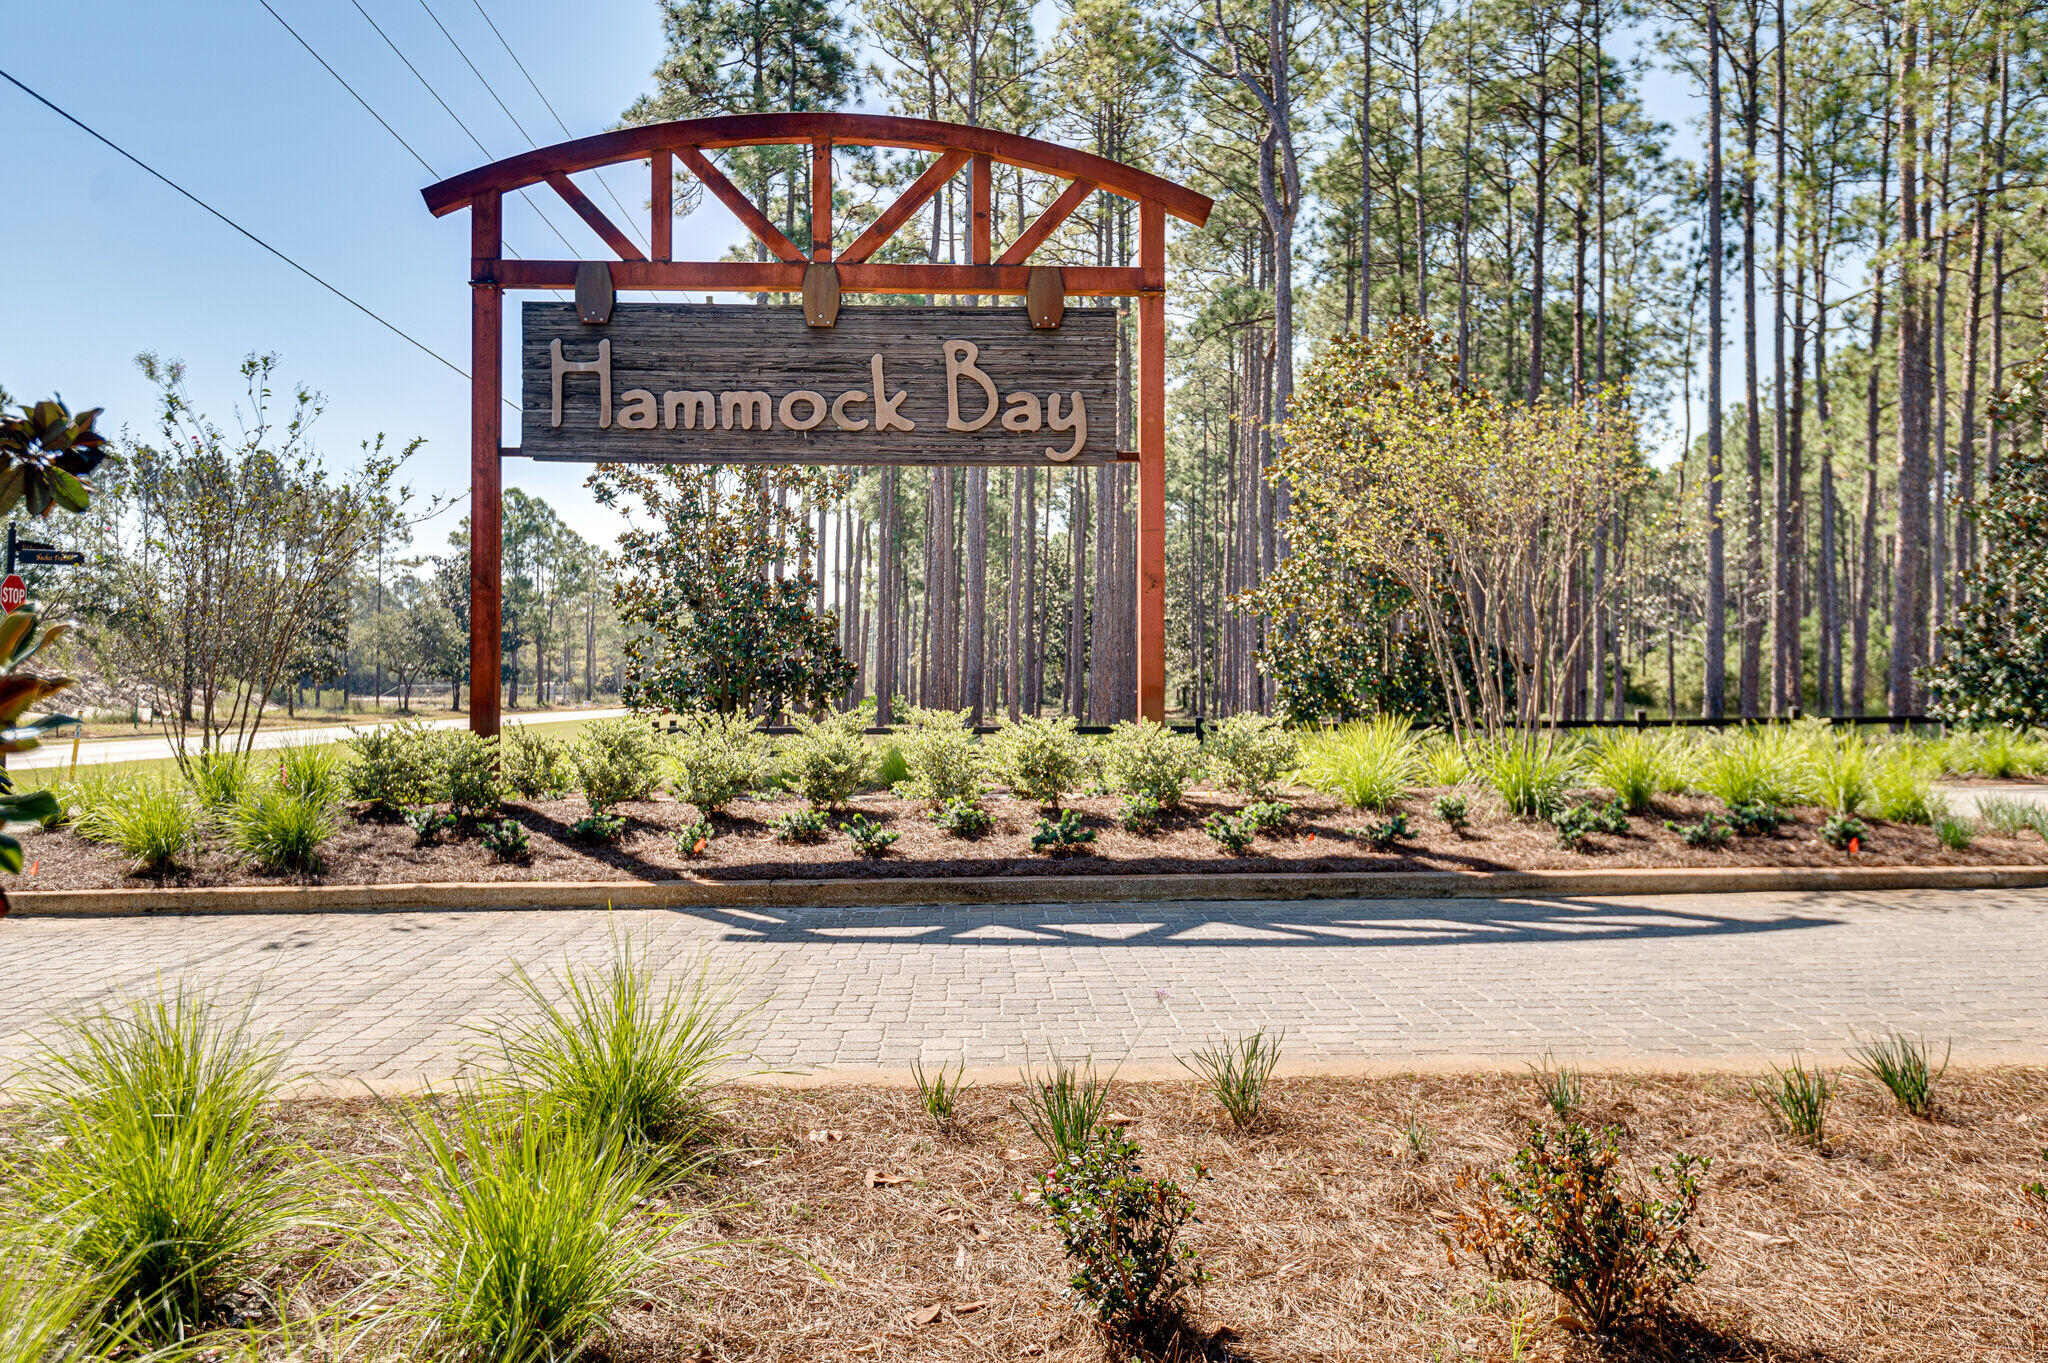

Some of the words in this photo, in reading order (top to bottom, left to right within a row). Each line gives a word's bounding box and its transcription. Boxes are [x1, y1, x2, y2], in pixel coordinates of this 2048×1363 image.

[550, 337, 916, 432] Hammock
[942, 339, 1087, 462] Bay
[2, 587, 25, 604] STOP
